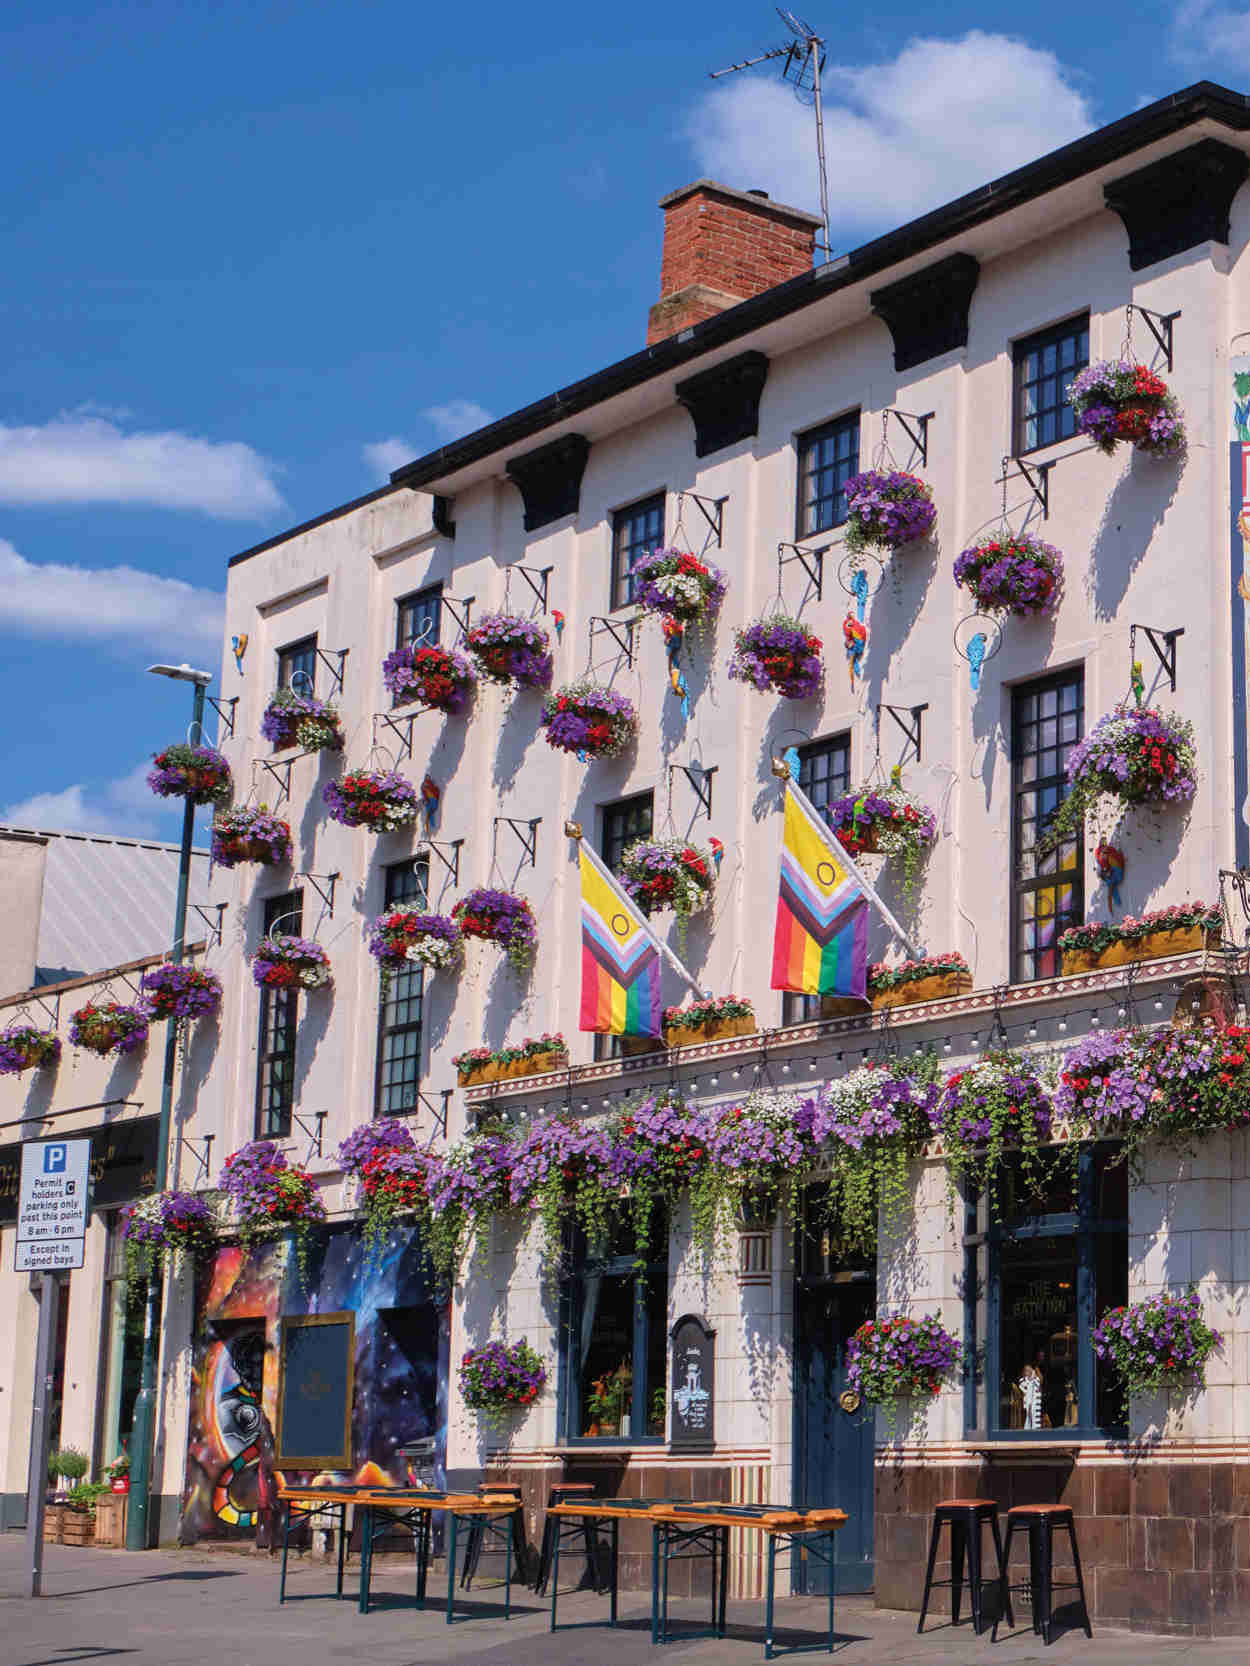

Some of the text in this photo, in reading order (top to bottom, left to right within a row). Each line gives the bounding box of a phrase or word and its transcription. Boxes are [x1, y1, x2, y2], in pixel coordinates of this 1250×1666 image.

[48, 1148, 64, 1171] P
[34, 1177, 63, 1188] Permit
[31, 1189, 64, 1200] holders
[26, 1198, 79, 1212] parking only
[20, 1210, 83, 1224] past this point
[35, 1227, 49, 1235] am
[54, 1224, 60, 1234] 6
[61, 1226, 75, 1235] pm
[30, 1244, 70, 1256] Except in
[24, 1255, 74, 1266] signed bays
